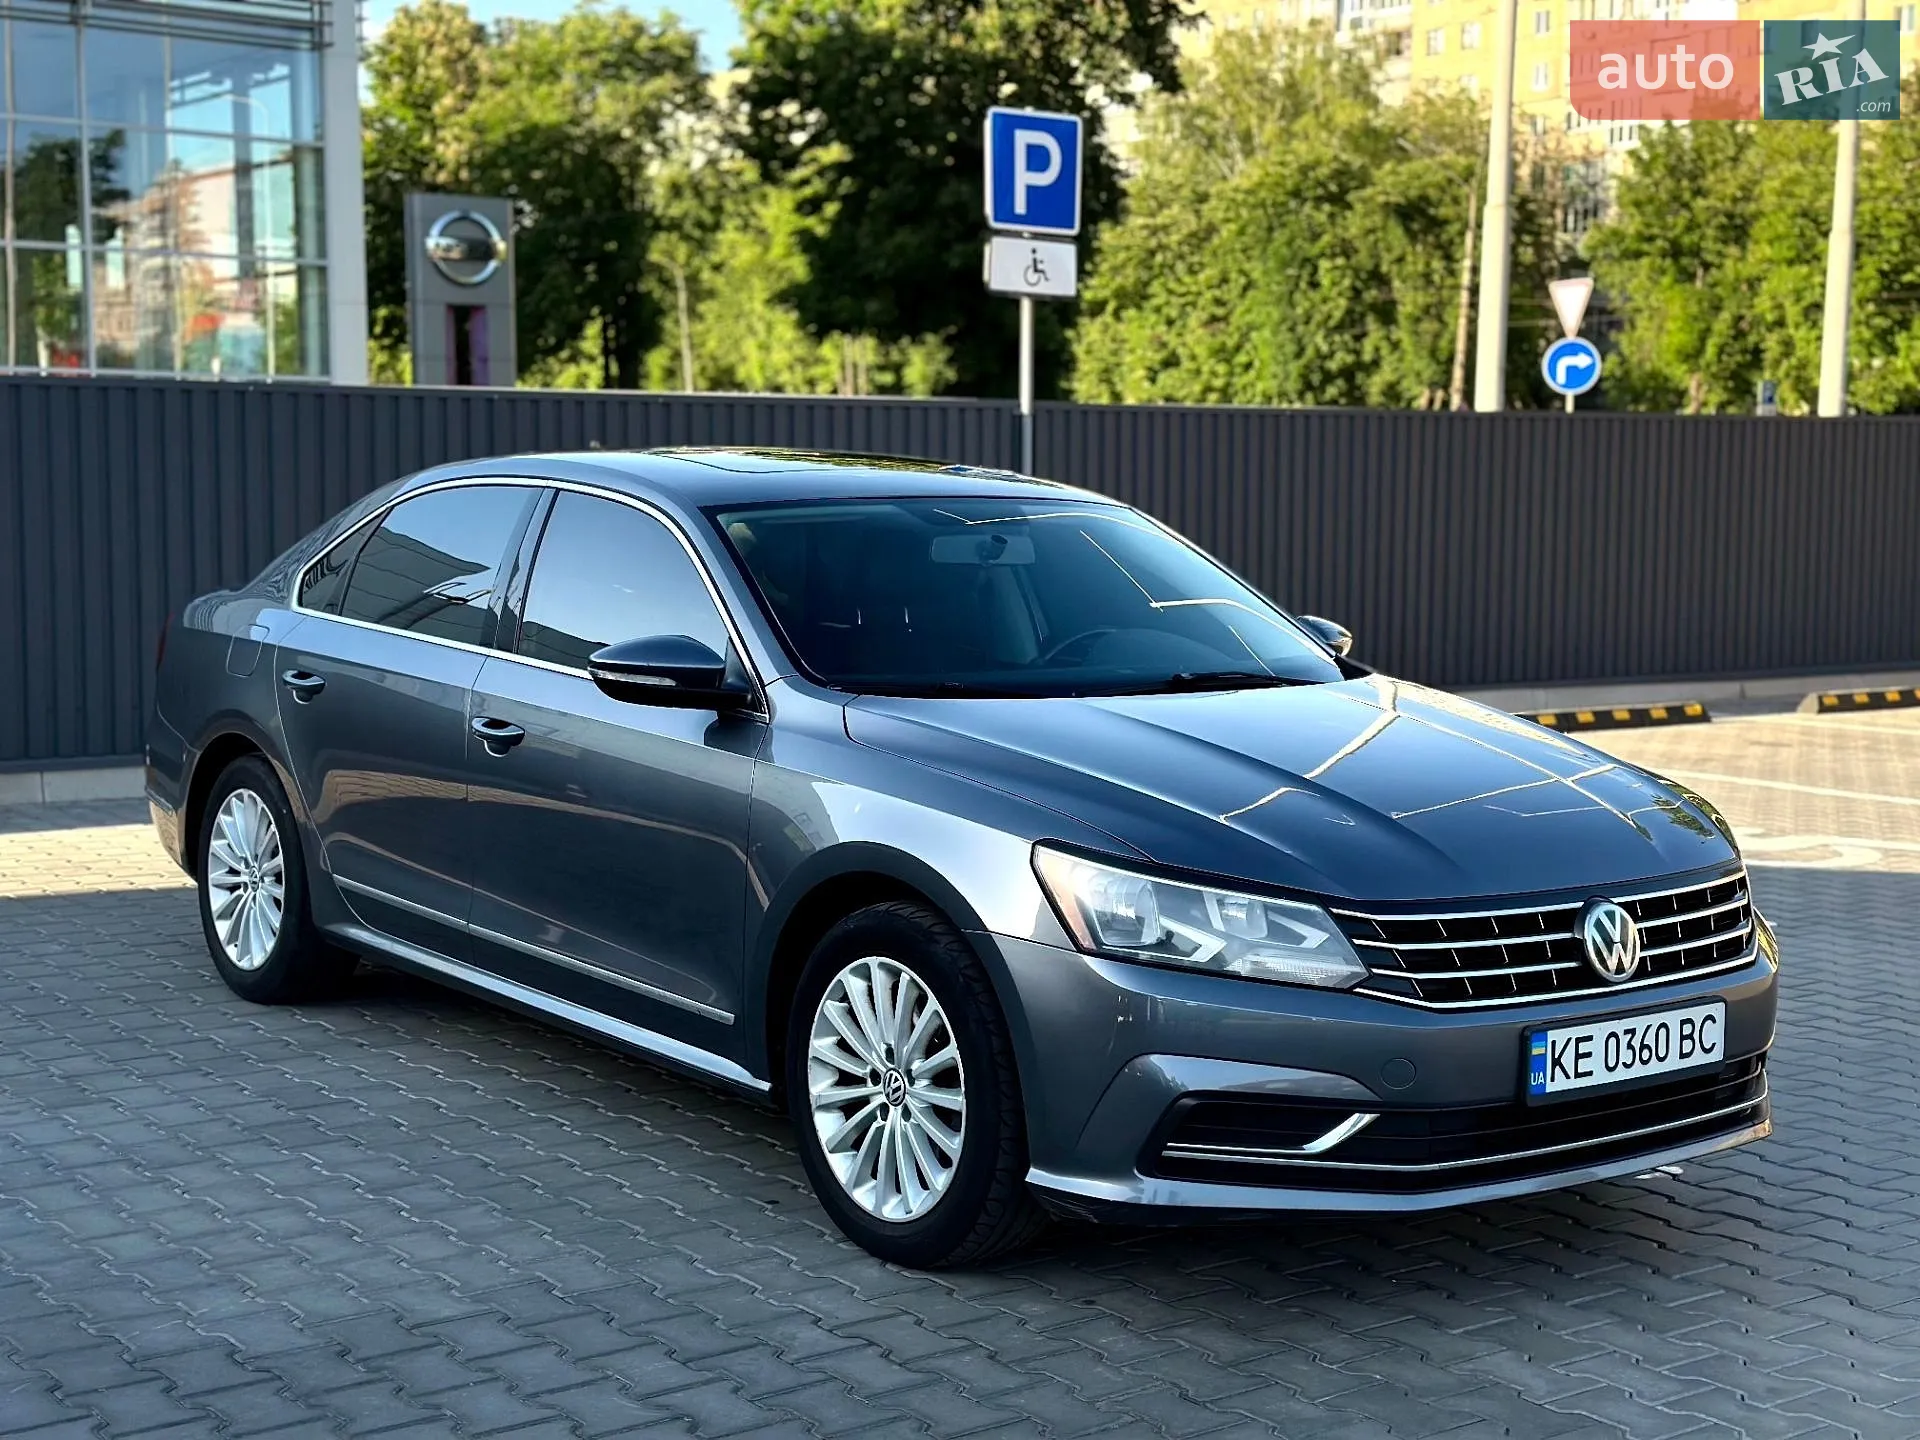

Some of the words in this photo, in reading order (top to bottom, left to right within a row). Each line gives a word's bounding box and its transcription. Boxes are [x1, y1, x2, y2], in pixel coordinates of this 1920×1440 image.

[1013, 128, 1062, 215] P
[1530, 1072, 1545, 1085] UA
[1550, 1034, 1594, 1083] KE
[1604, 1022, 1670, 1072] 0360
[1679, 1014, 1717, 1060] BC
